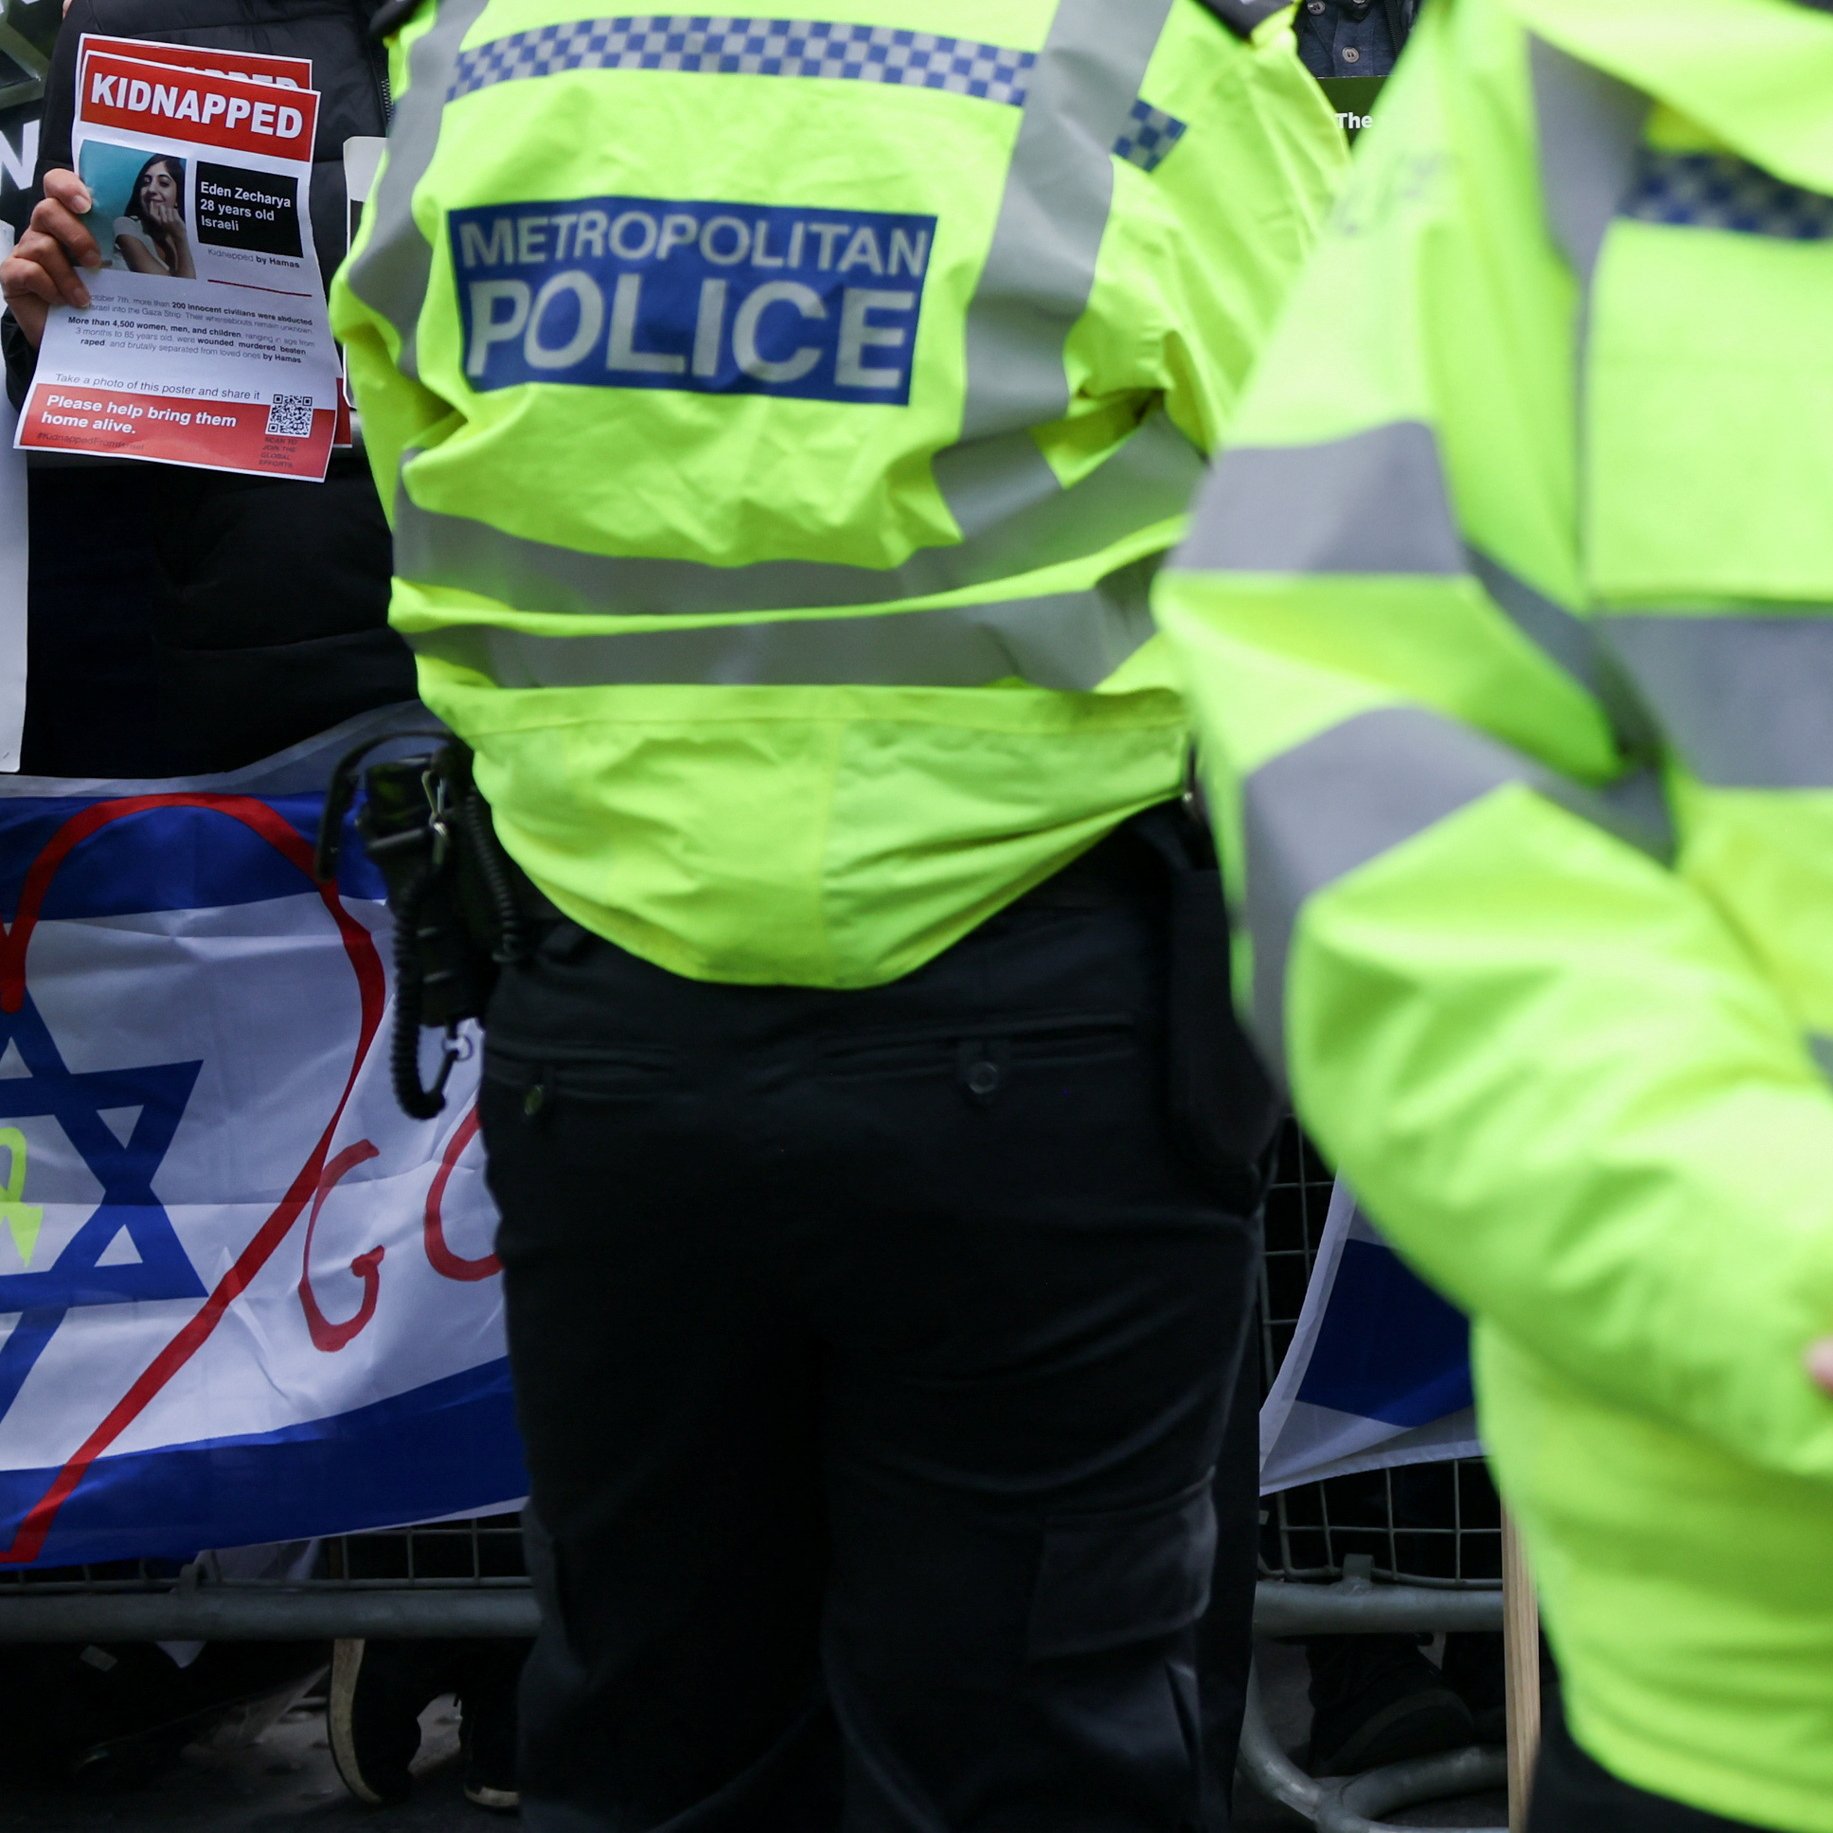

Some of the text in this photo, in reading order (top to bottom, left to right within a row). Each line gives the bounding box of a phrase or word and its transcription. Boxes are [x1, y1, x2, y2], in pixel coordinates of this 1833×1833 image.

[91, 73, 303, 139] KIDNAPPED
[1335, 111, 1374, 129] The
[201, 181, 291, 209] Eden Zecharya
[200, 199, 274, 221] 28 years old
[201, 215, 239, 231] Israeli
[459, 210, 927, 276] METROPOLITAN
[256, 255, 266, 265] by
[270, 257, 300, 268] Hamas
[68, 316, 89, 325] More
[92, 317, 110, 326] than
[112, 320, 134, 328] 4,500
[467, 269, 916, 389] POLICE
[263, 353, 273, 361] by
[56, 373, 260, 400] Take a photo of this poster and share it
[47, 395, 236, 427] Please help bring them
[41, 412, 136, 434] home alive.
